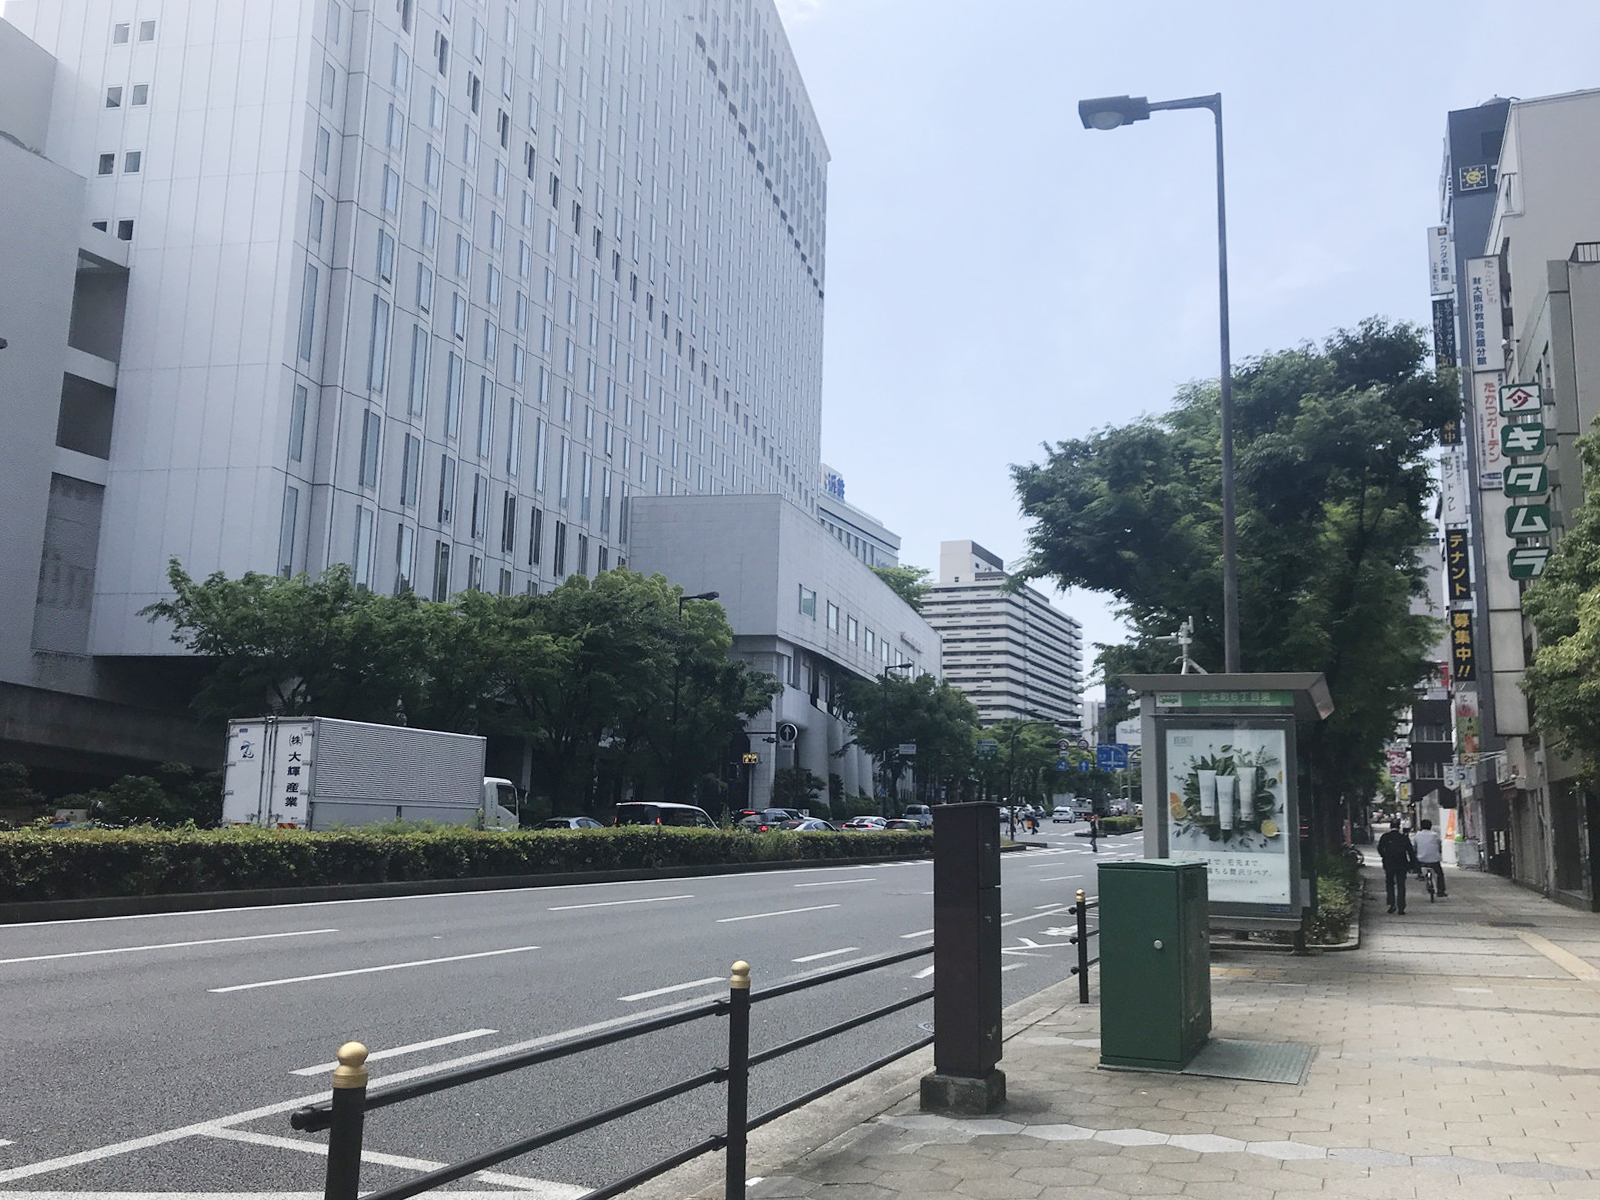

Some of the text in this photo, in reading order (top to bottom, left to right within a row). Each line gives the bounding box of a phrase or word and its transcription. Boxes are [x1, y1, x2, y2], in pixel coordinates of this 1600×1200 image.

[1484, 382, 1500, 463] たかつガーデン
[1450, 535, 1466, 596] テナント
